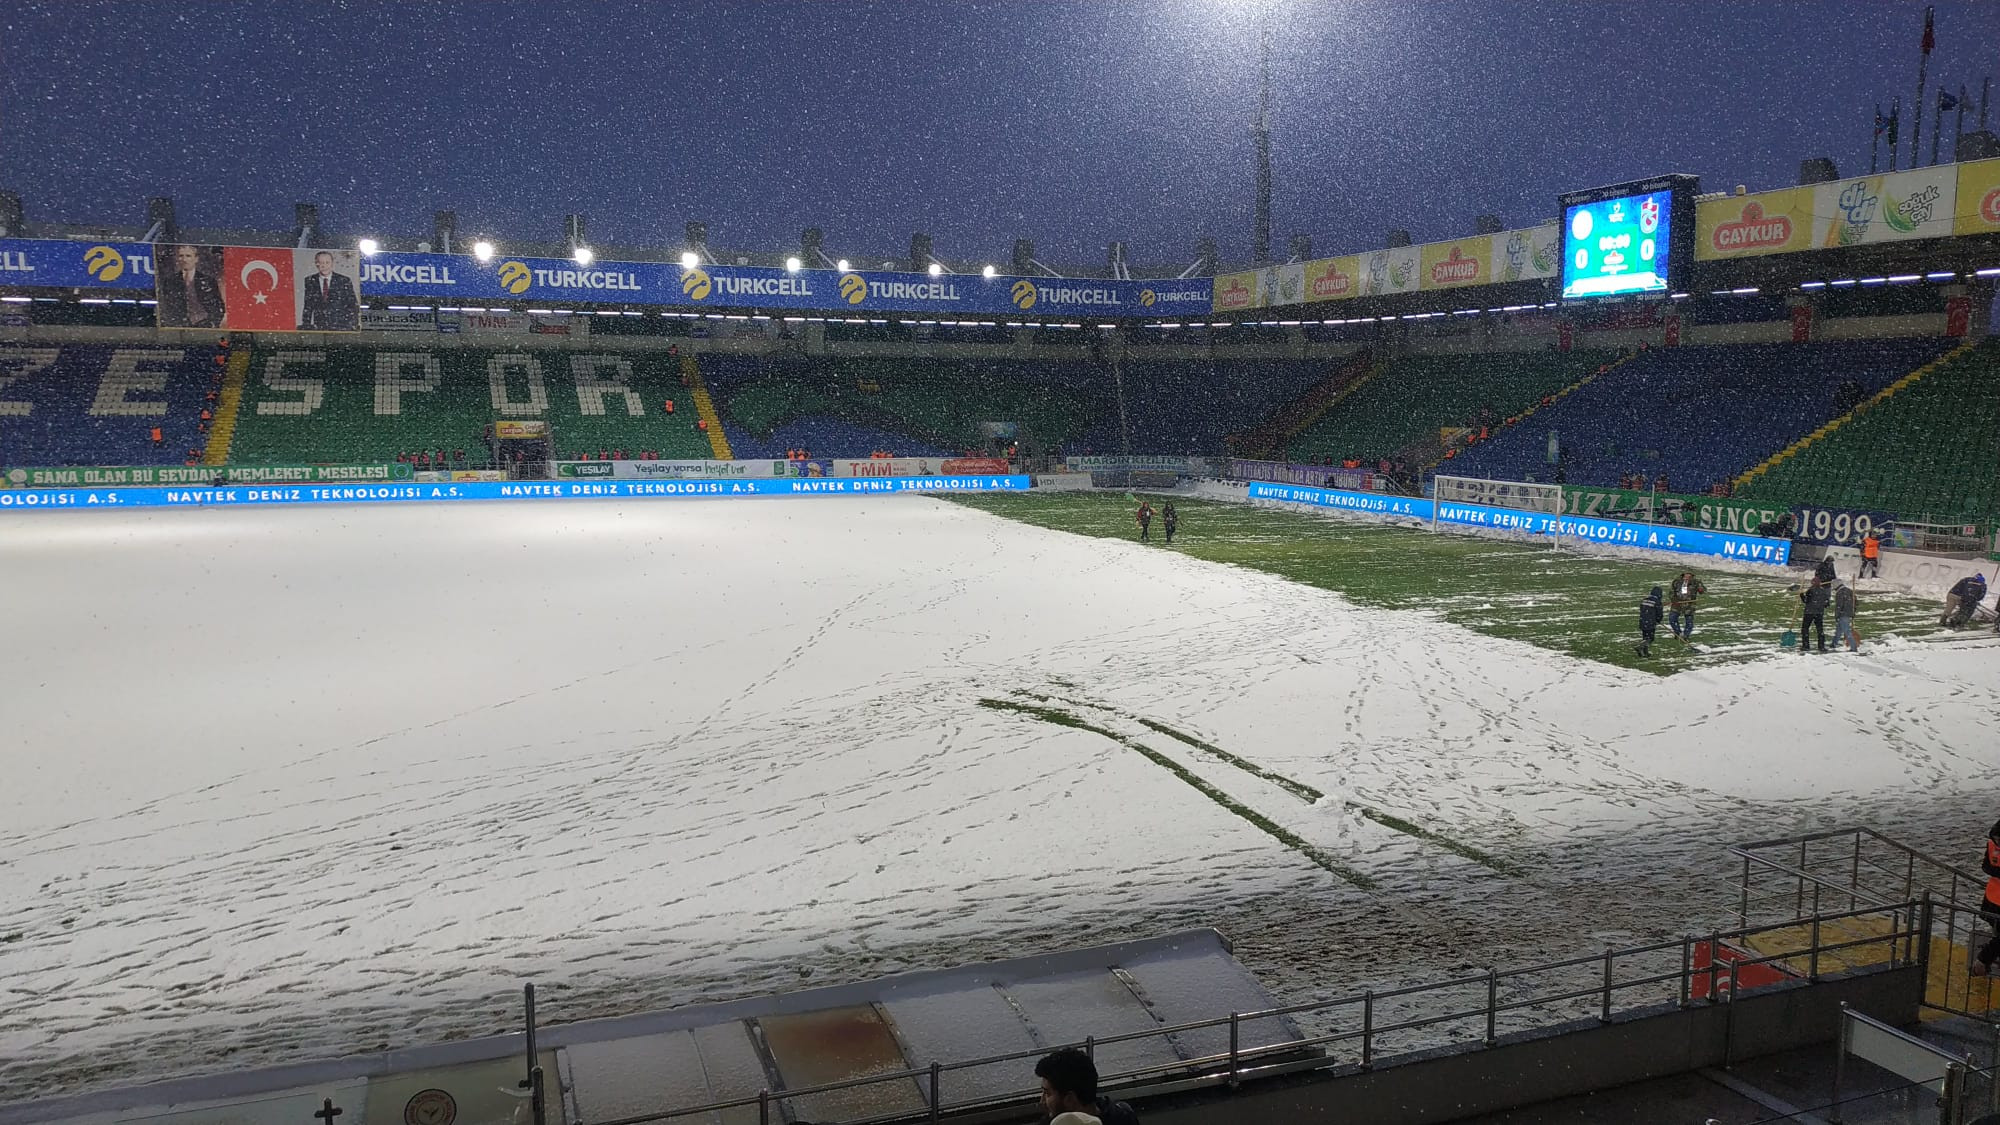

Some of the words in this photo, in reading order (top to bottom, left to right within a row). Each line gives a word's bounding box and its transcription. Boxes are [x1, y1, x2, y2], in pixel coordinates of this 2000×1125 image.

[360, 264, 456, 285] URKCELL
[534, 269, 641, 291] TURKCELL
[714, 276, 812, 296] TURKCELL
[869, 281, 960, 301] TURKCELL
[1039, 287, 1121, 305] TURKCELL
[1155, 291, 1209, 302] TURKCELL
[33, 469, 78, 484] SANA
[84, 469, 127, 483] OLAN
[132, 469, 153, 482] BU
[229, 467, 313, 481] MEMLEKET
[634, 463, 671, 475] Yeşilay
[850, 462, 893, 477] TMM
[501, 485, 562, 496] NAVTEK
[792, 481, 845, 491] NAVTEK
[1257, 486, 1289, 499] NAVTEK
[167, 490, 237, 503] NAVTEK
[1440, 507, 1487, 523] NAVTEK
[1723, 540, 1785, 561] NAVTE
